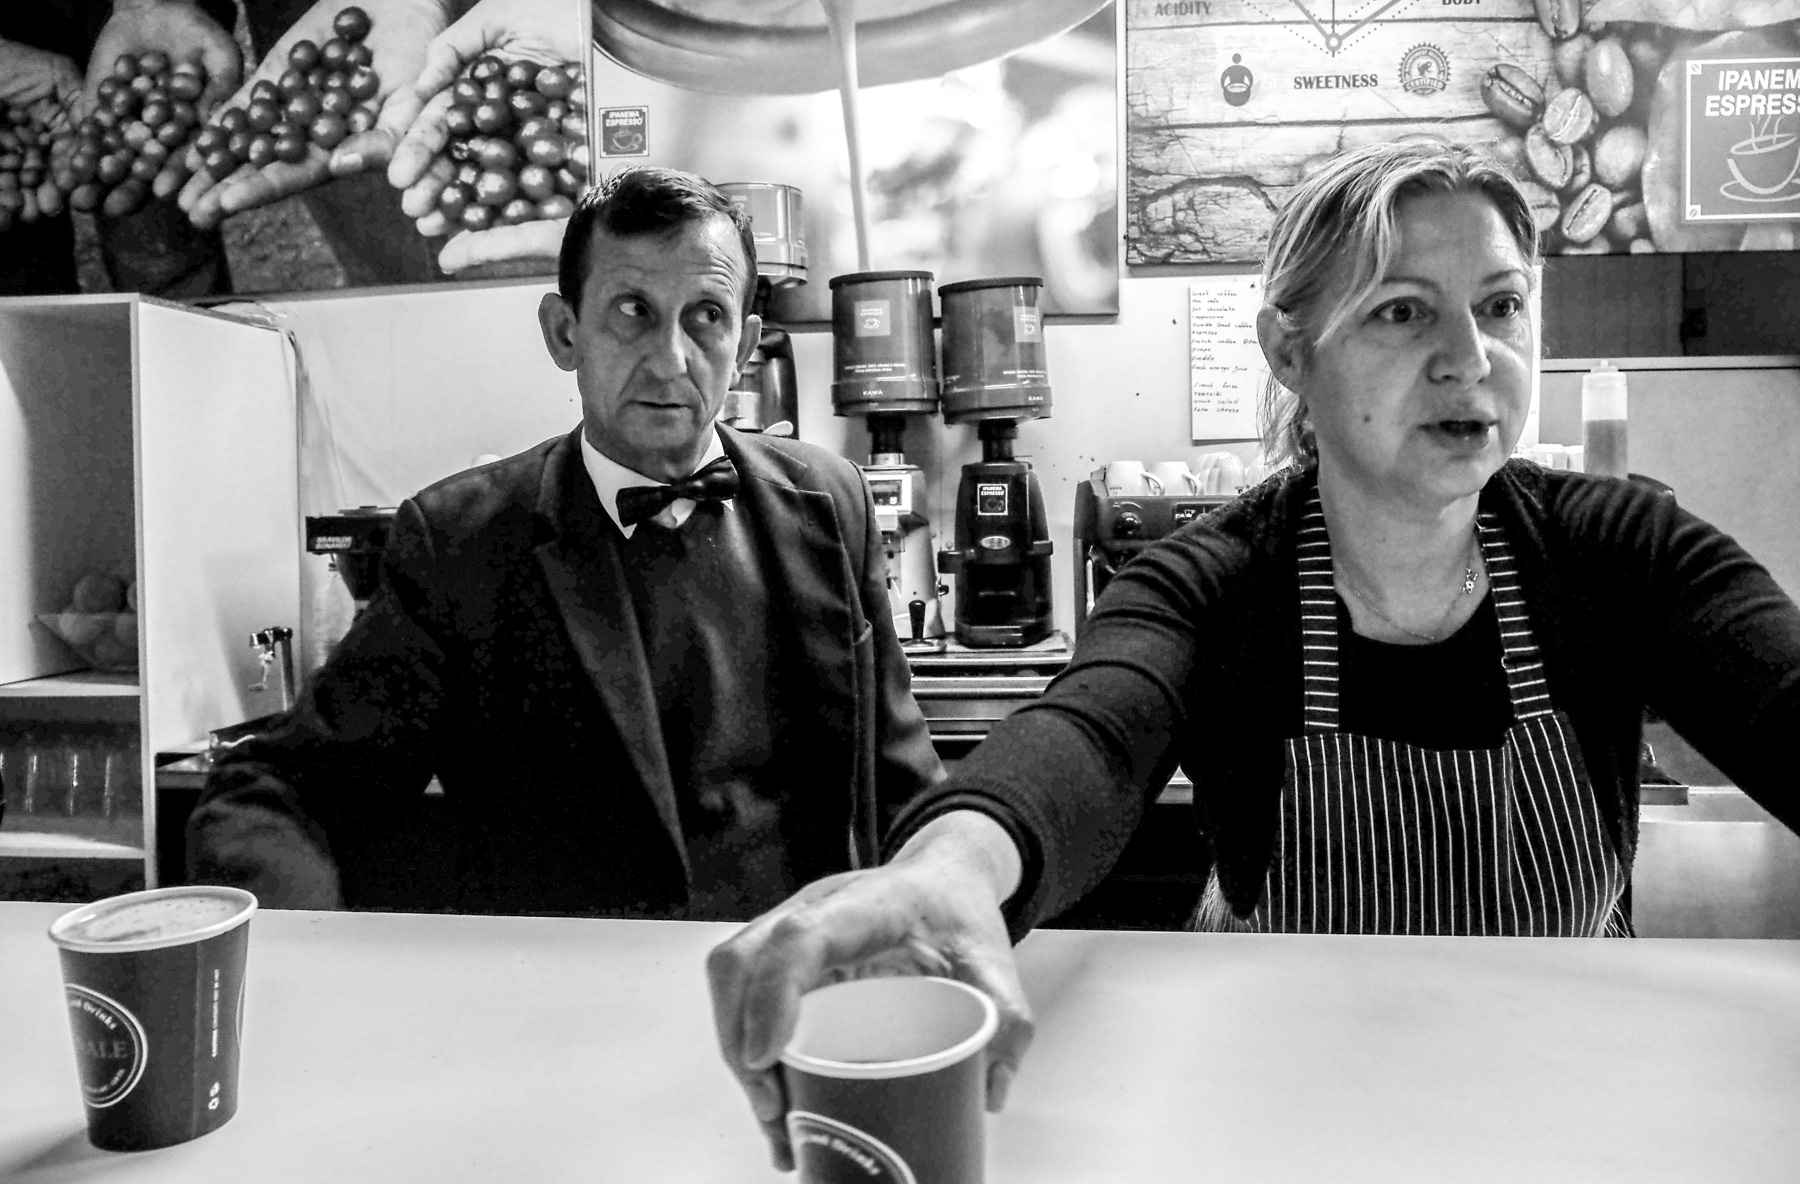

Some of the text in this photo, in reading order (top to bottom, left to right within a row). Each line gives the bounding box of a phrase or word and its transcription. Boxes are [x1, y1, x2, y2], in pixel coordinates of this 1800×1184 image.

[1154, 1, 1212, 16] ACIDITY
[1293, 74, 1379, 90] SWEETNESS
[1705, 93, 1800, 117] ESPRES
[605, 117, 643, 127] ESPRESSO
[608, 110, 640, 119] IPANEMA
